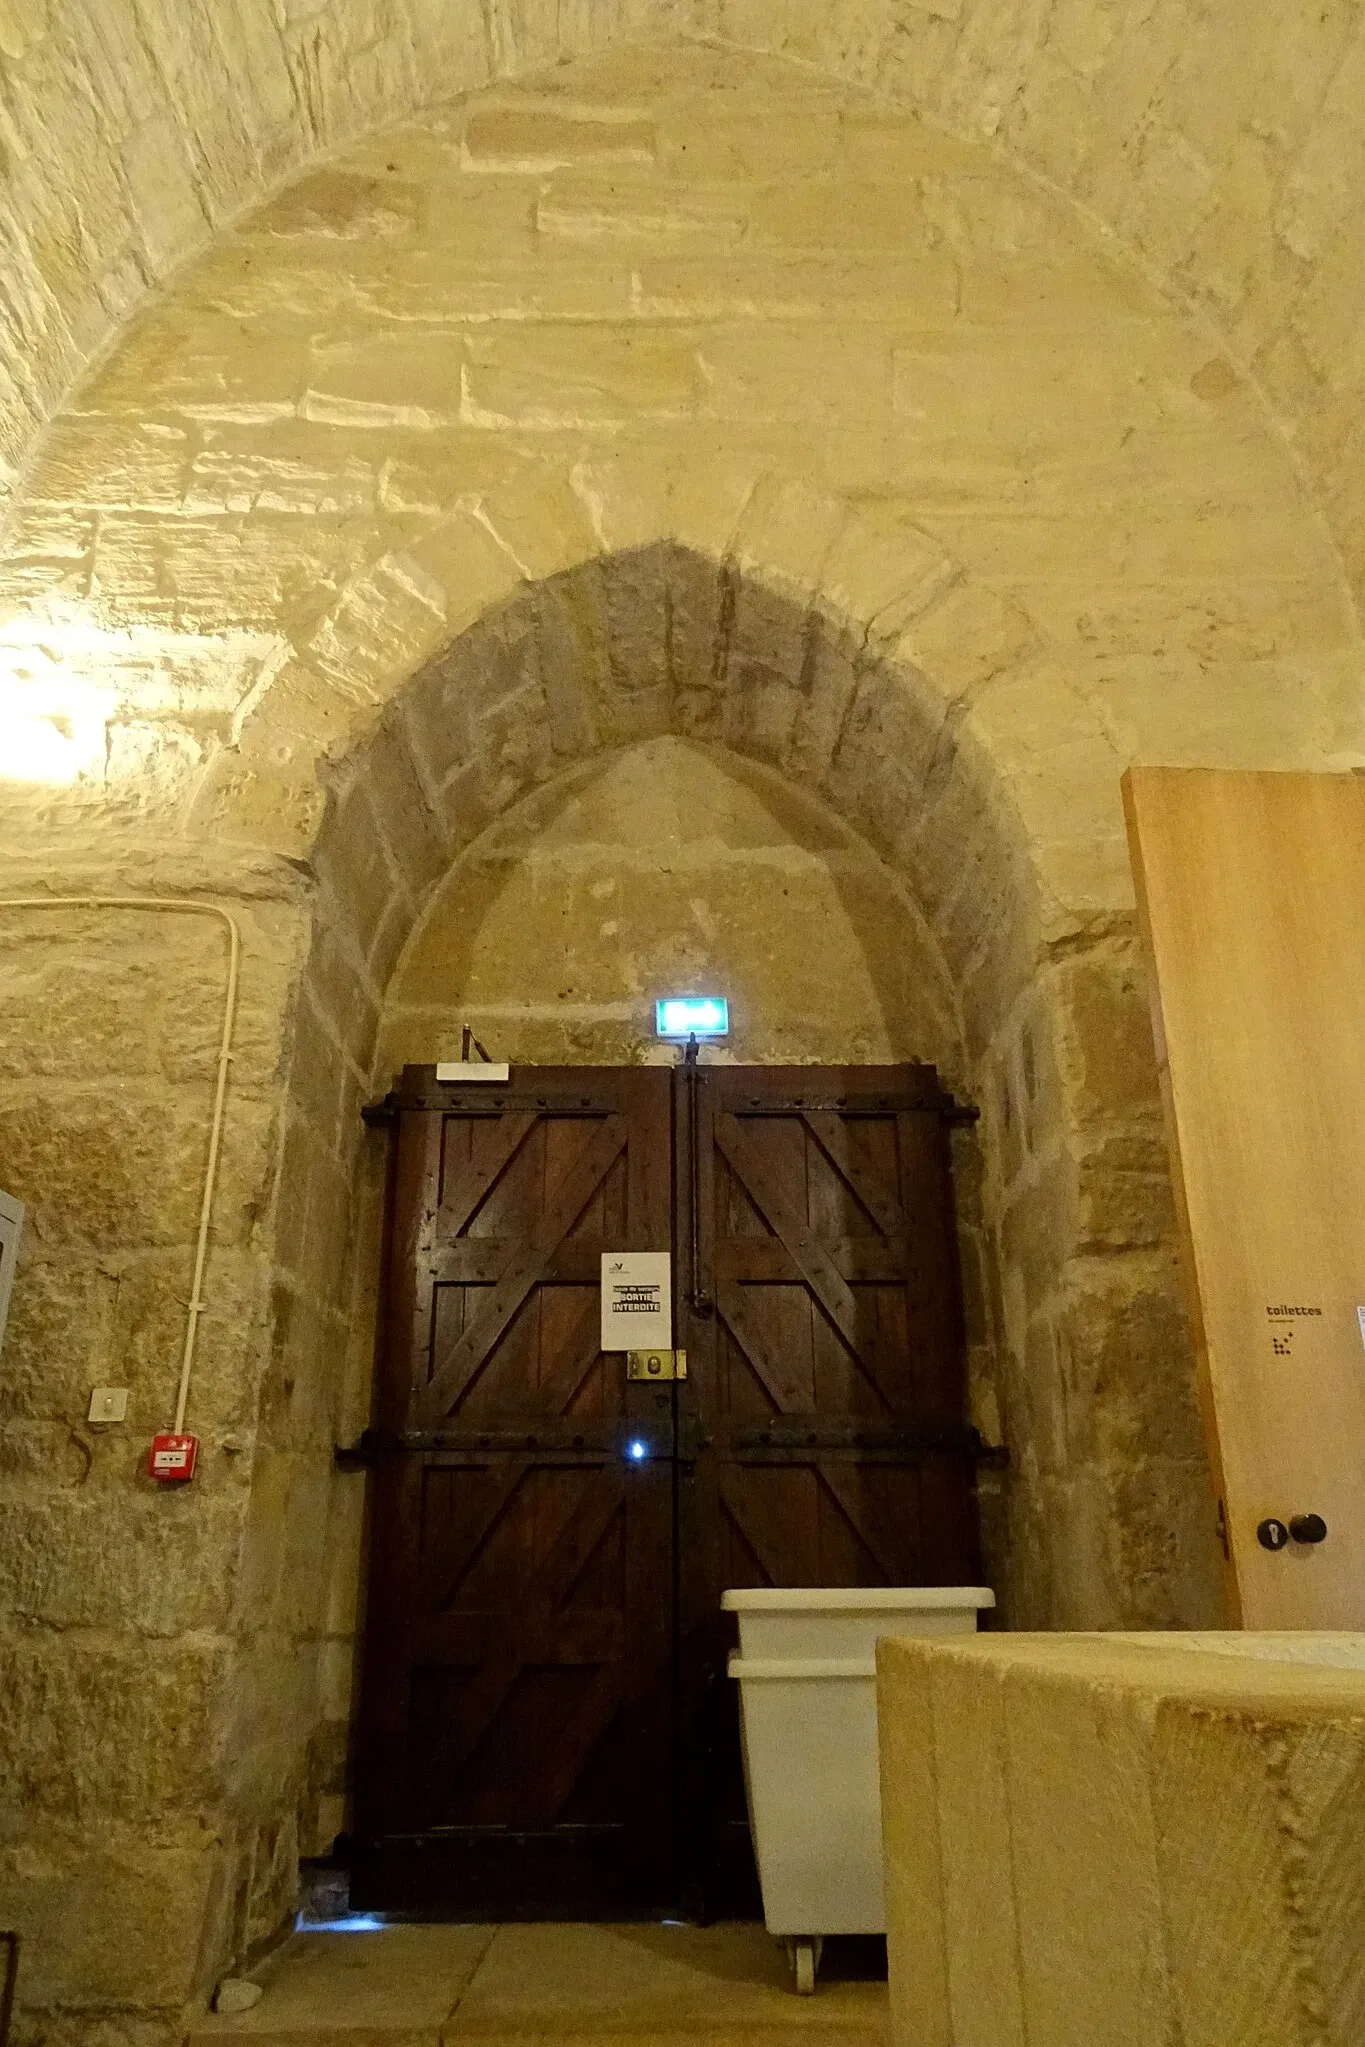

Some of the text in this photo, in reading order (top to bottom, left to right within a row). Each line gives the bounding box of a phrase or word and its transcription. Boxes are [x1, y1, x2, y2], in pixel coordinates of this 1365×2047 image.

[620, 1293, 652, 1301] SORTIE
[613, 1303, 660, 1311] INTERDITE
[1266, 1305, 1322, 1316] toilettes
